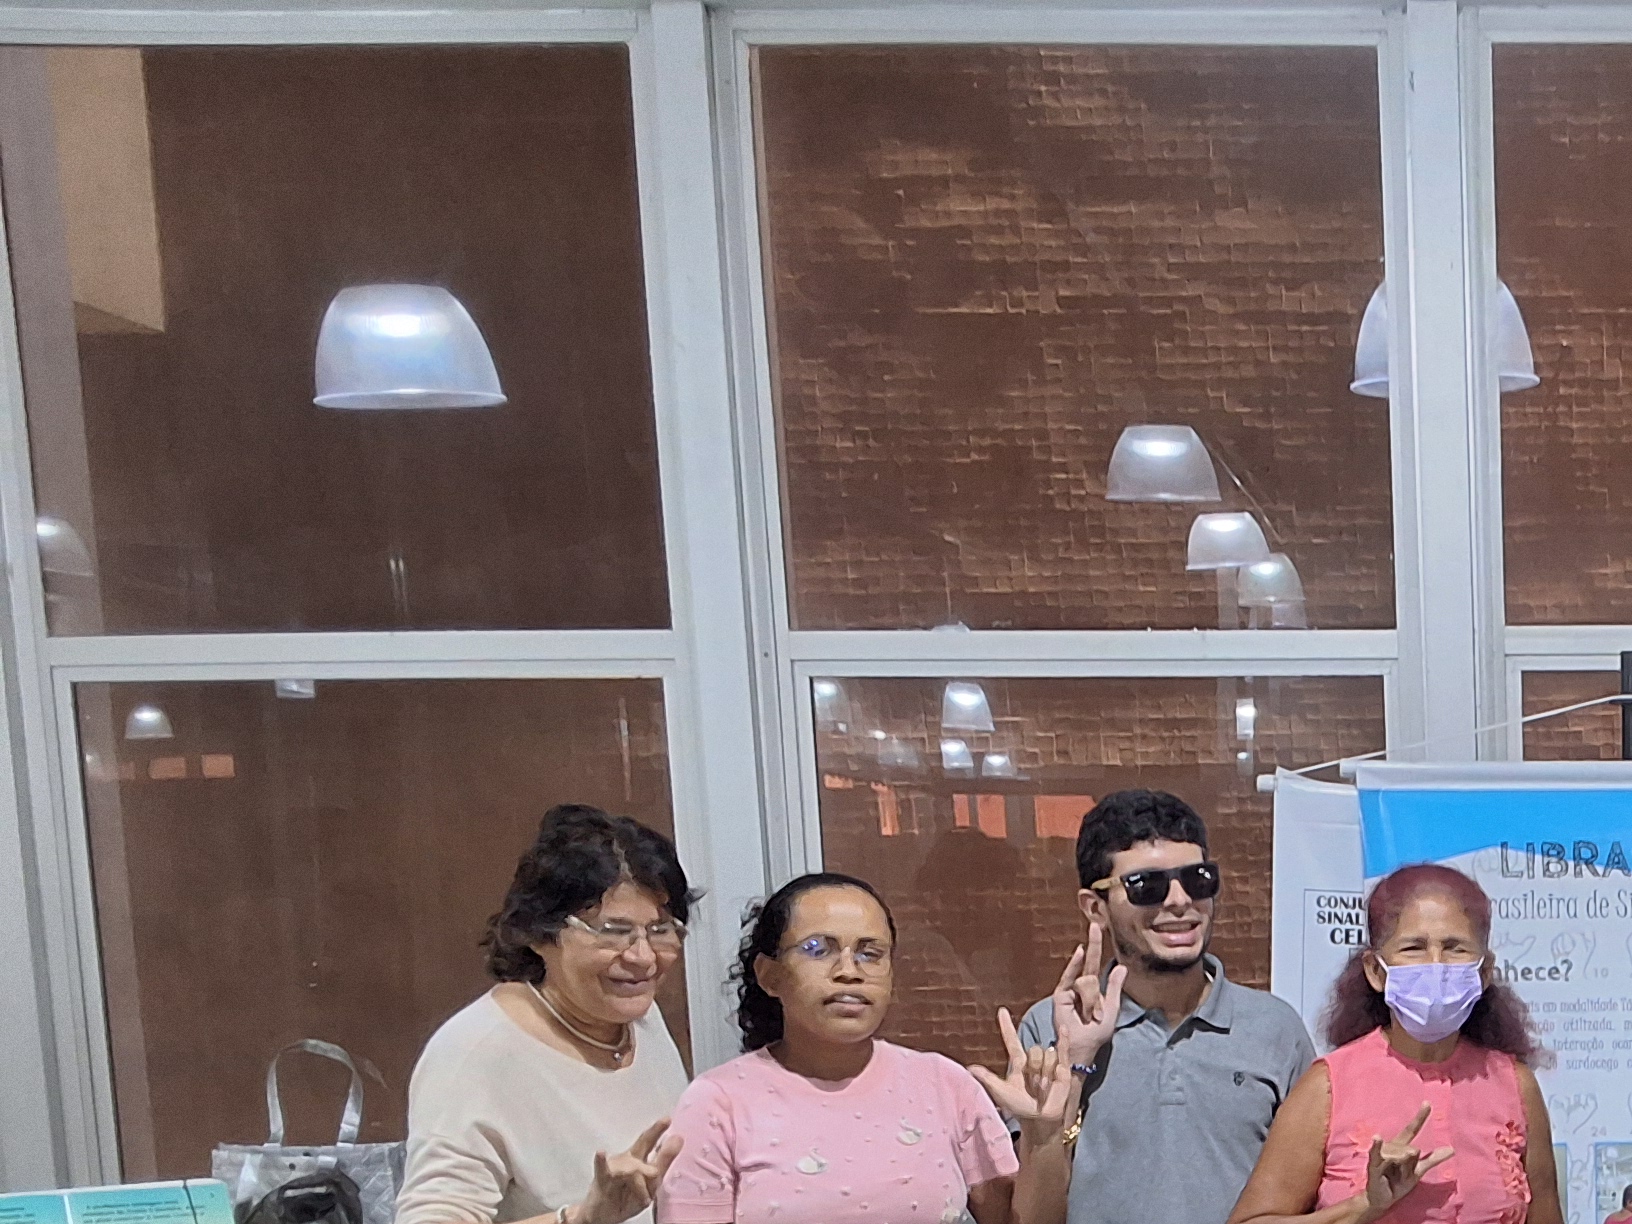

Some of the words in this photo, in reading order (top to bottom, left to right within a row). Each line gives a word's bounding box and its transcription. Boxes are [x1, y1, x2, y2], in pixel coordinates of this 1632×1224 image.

[1316, 895, 1366, 911] CONJU
[1491, 889, 1578, 919] rasileira
[1586, 889, 1610, 918] de
[1330, 928, 1365, 945] CEL
[1492, 959, 1573, 982] nhece?
